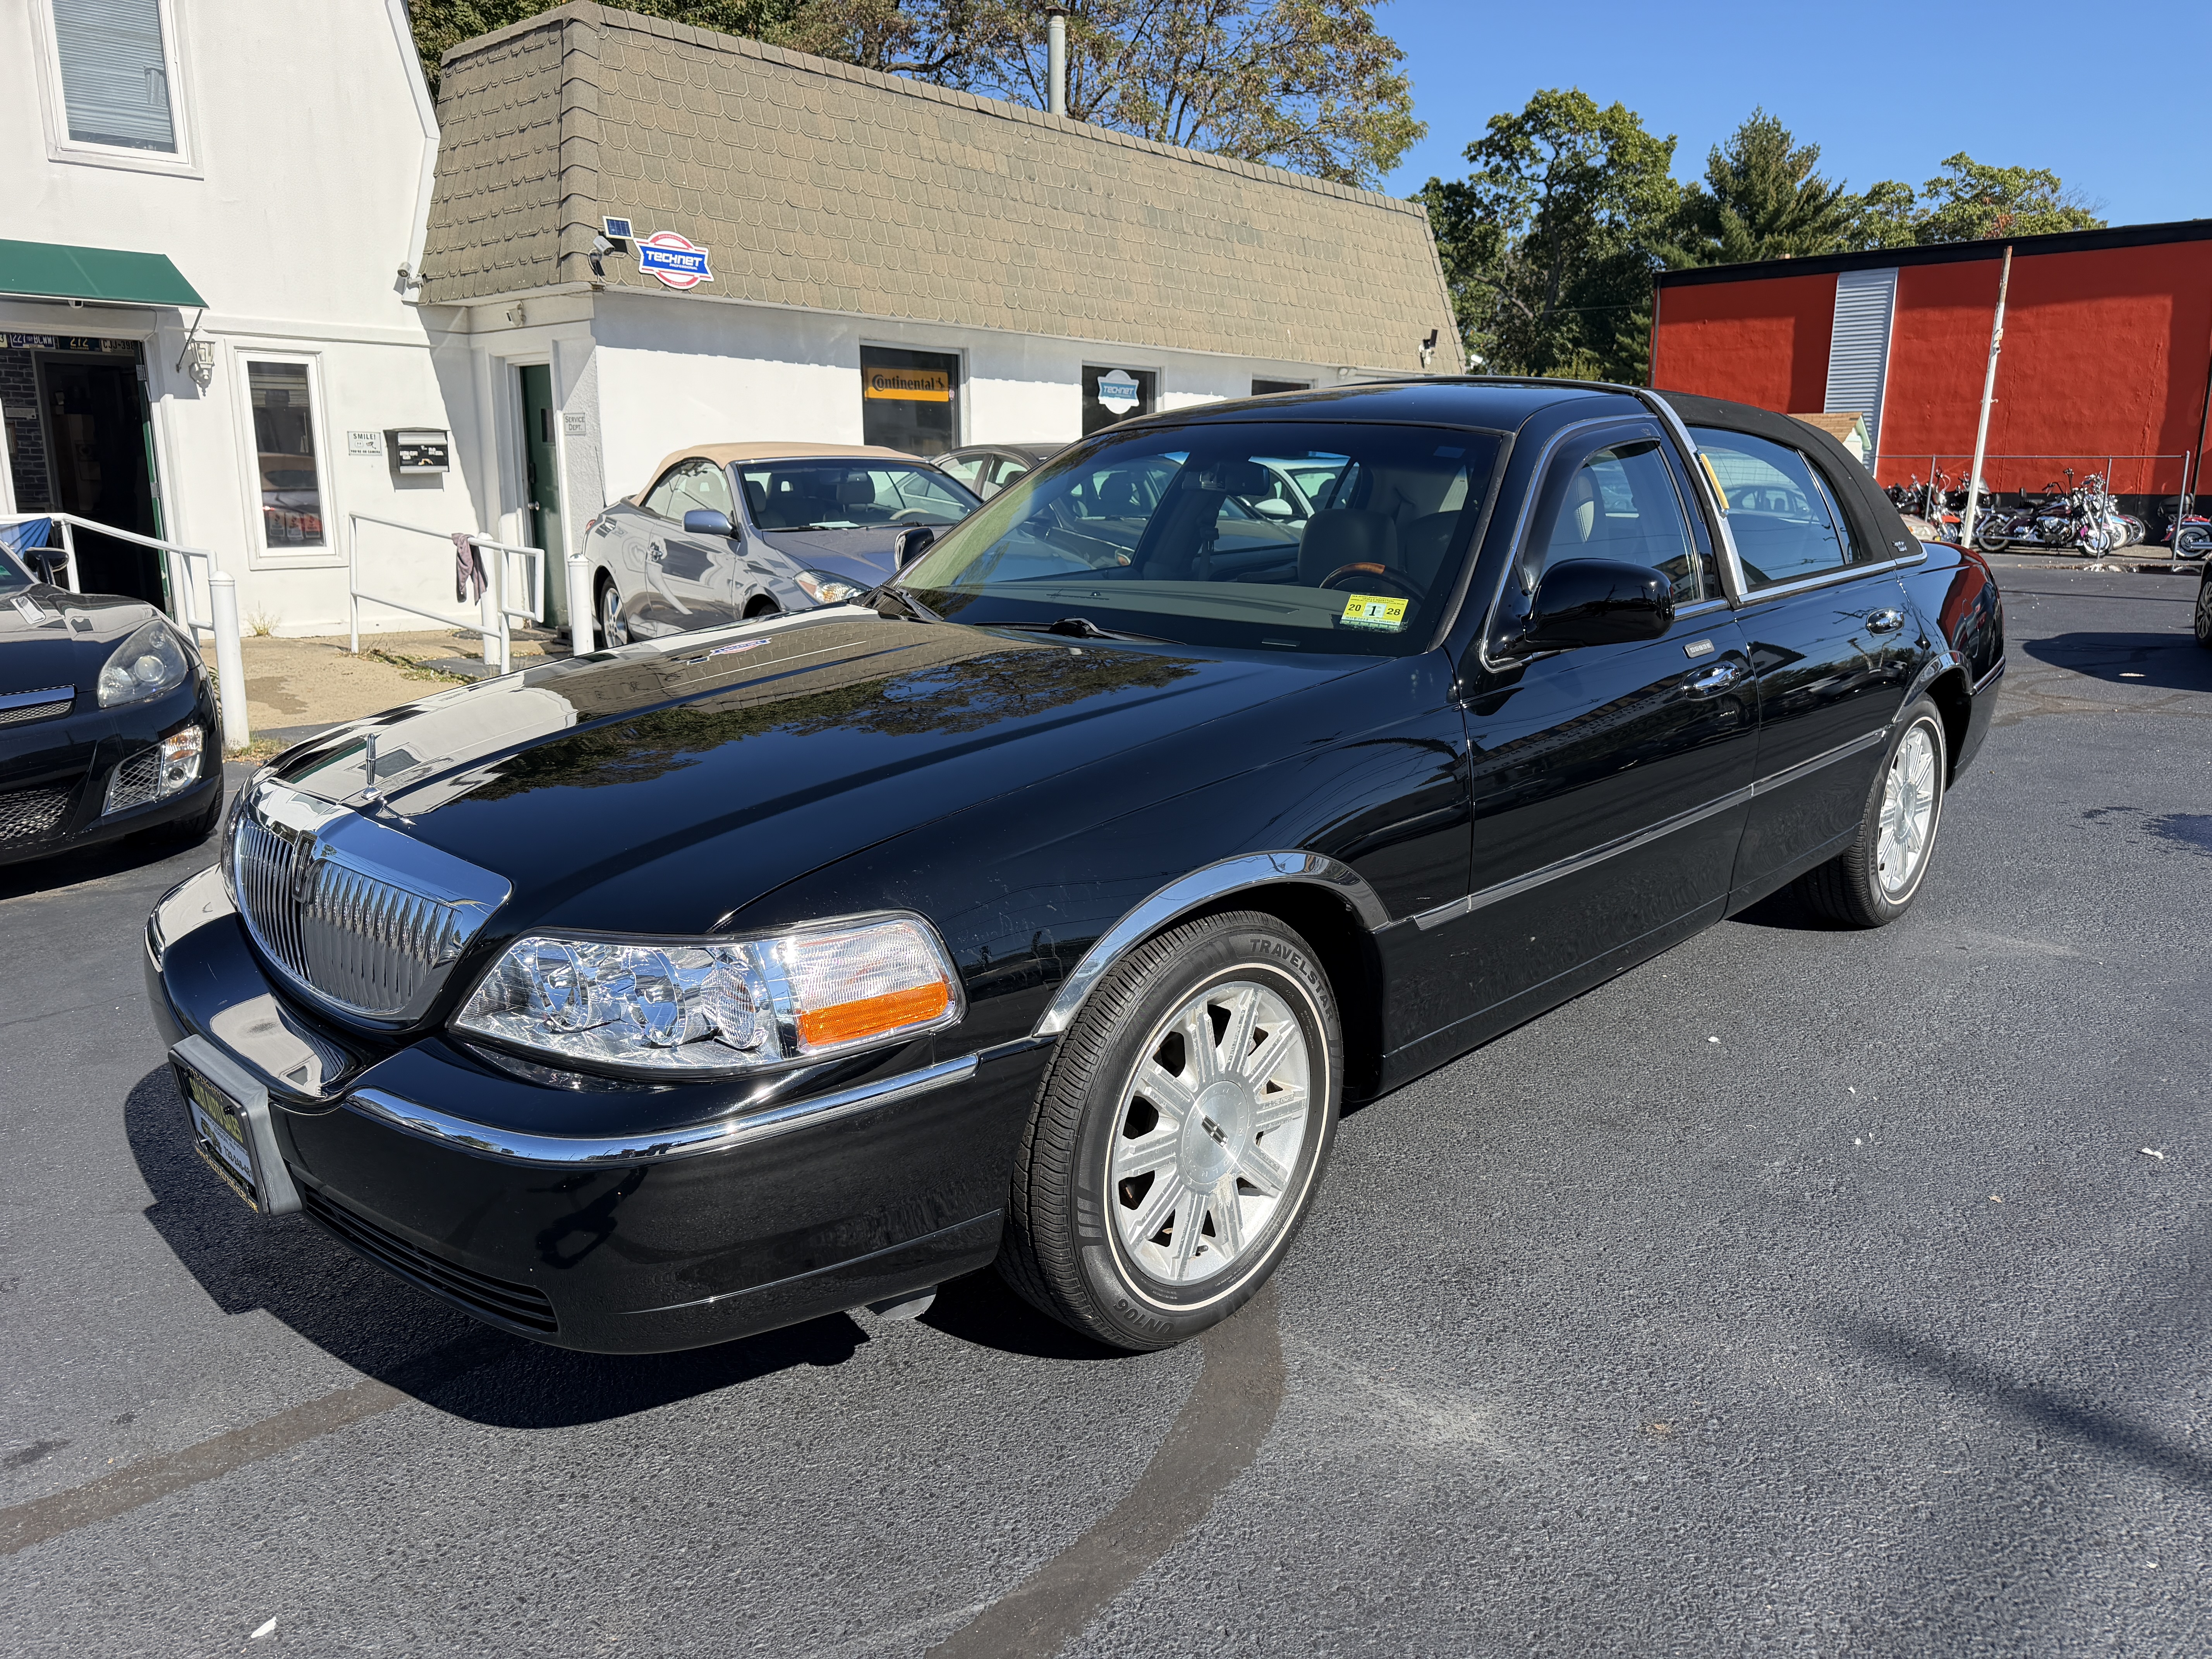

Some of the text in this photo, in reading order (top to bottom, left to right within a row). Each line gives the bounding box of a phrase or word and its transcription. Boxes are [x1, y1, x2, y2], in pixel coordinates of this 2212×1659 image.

[872, 374, 935, 392] Continental
[1369, 606, 1377, 616] 1
[1250, 939, 1333, 1023] TRAVELSTAR
[205, 1091, 223, 1125] AUTO
[220, 1105, 243, 1143] SALES
[1113, 1298, 1175, 1334] UN106
